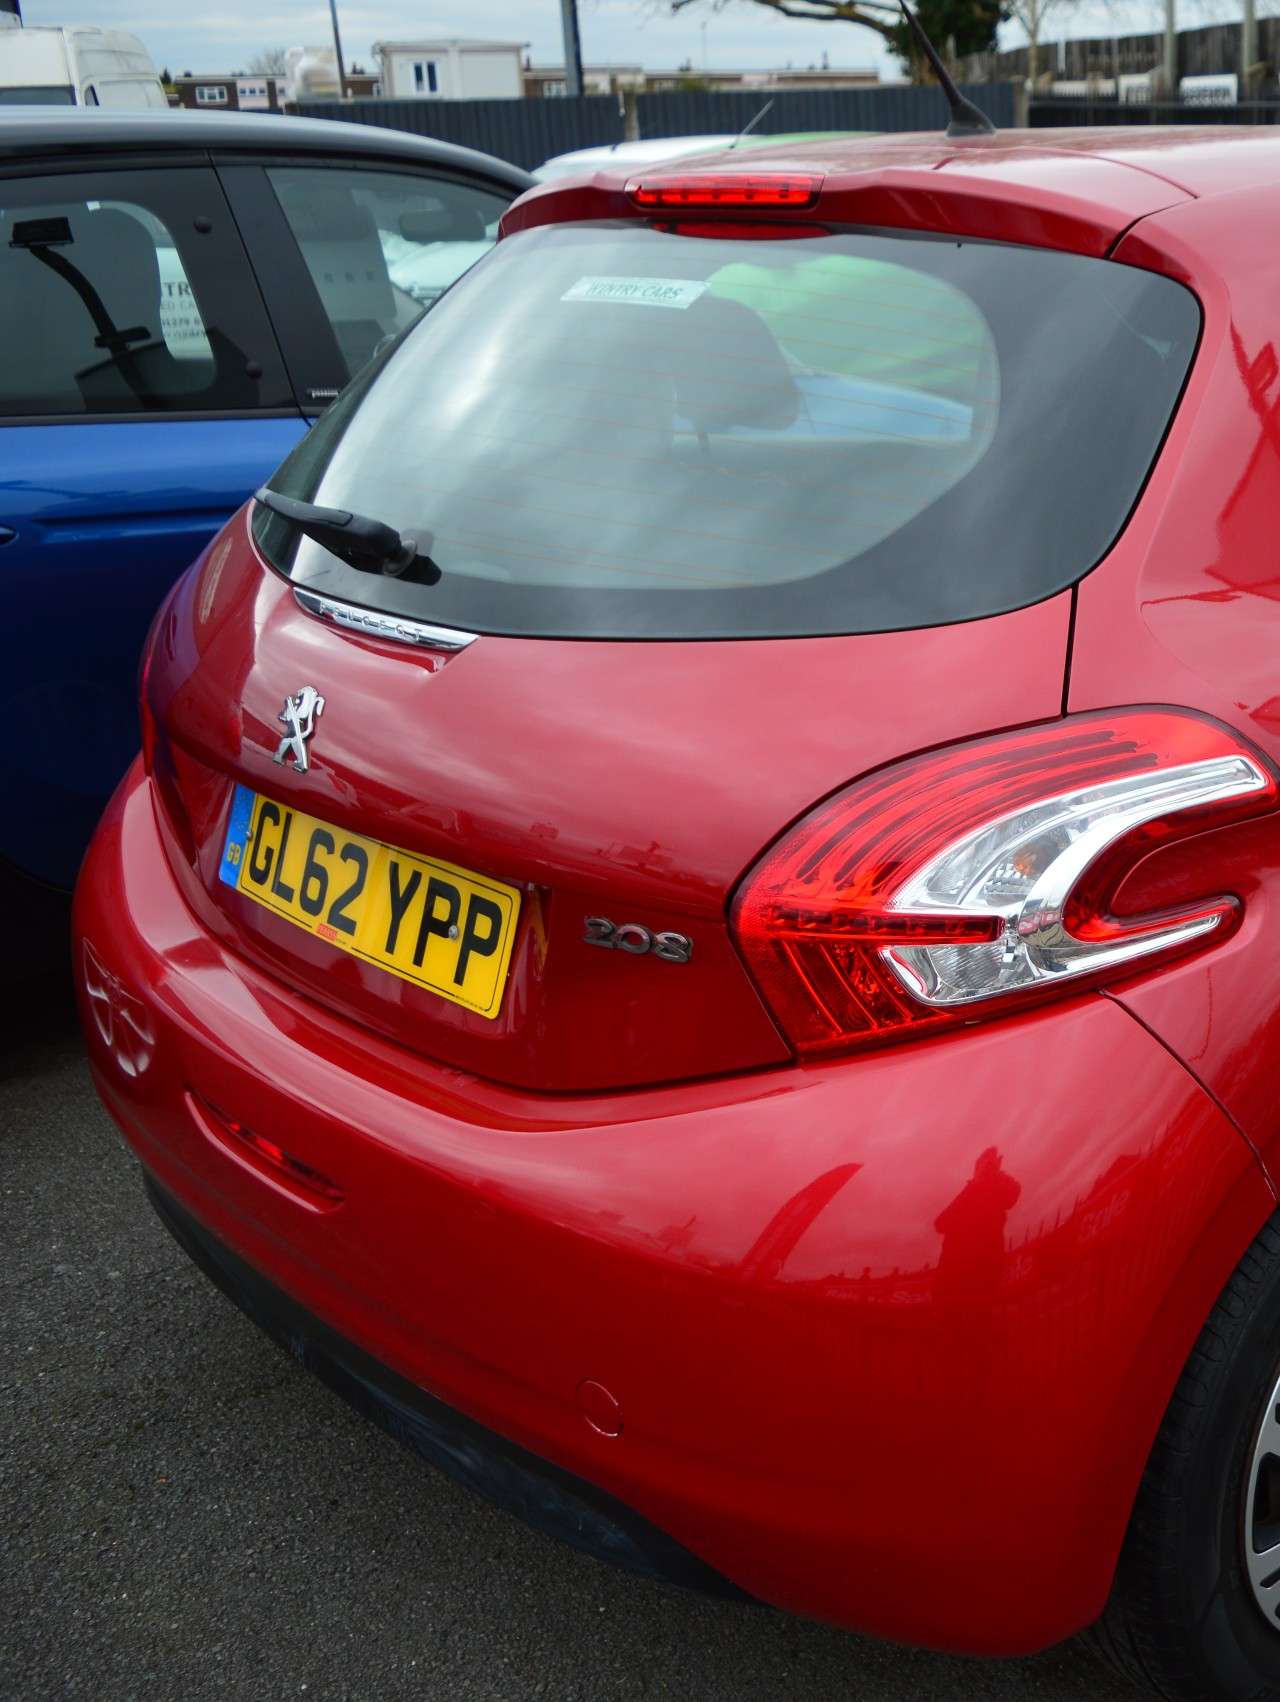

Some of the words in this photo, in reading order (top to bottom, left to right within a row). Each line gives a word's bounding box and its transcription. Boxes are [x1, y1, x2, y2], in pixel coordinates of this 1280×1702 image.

[320, 600, 423, 642] PEUGEOT
[227, 841, 241, 865] GB
[250, 801, 368, 937] GL62
[385, 860, 503, 987] YPP
[583, 916, 693, 962] 208
